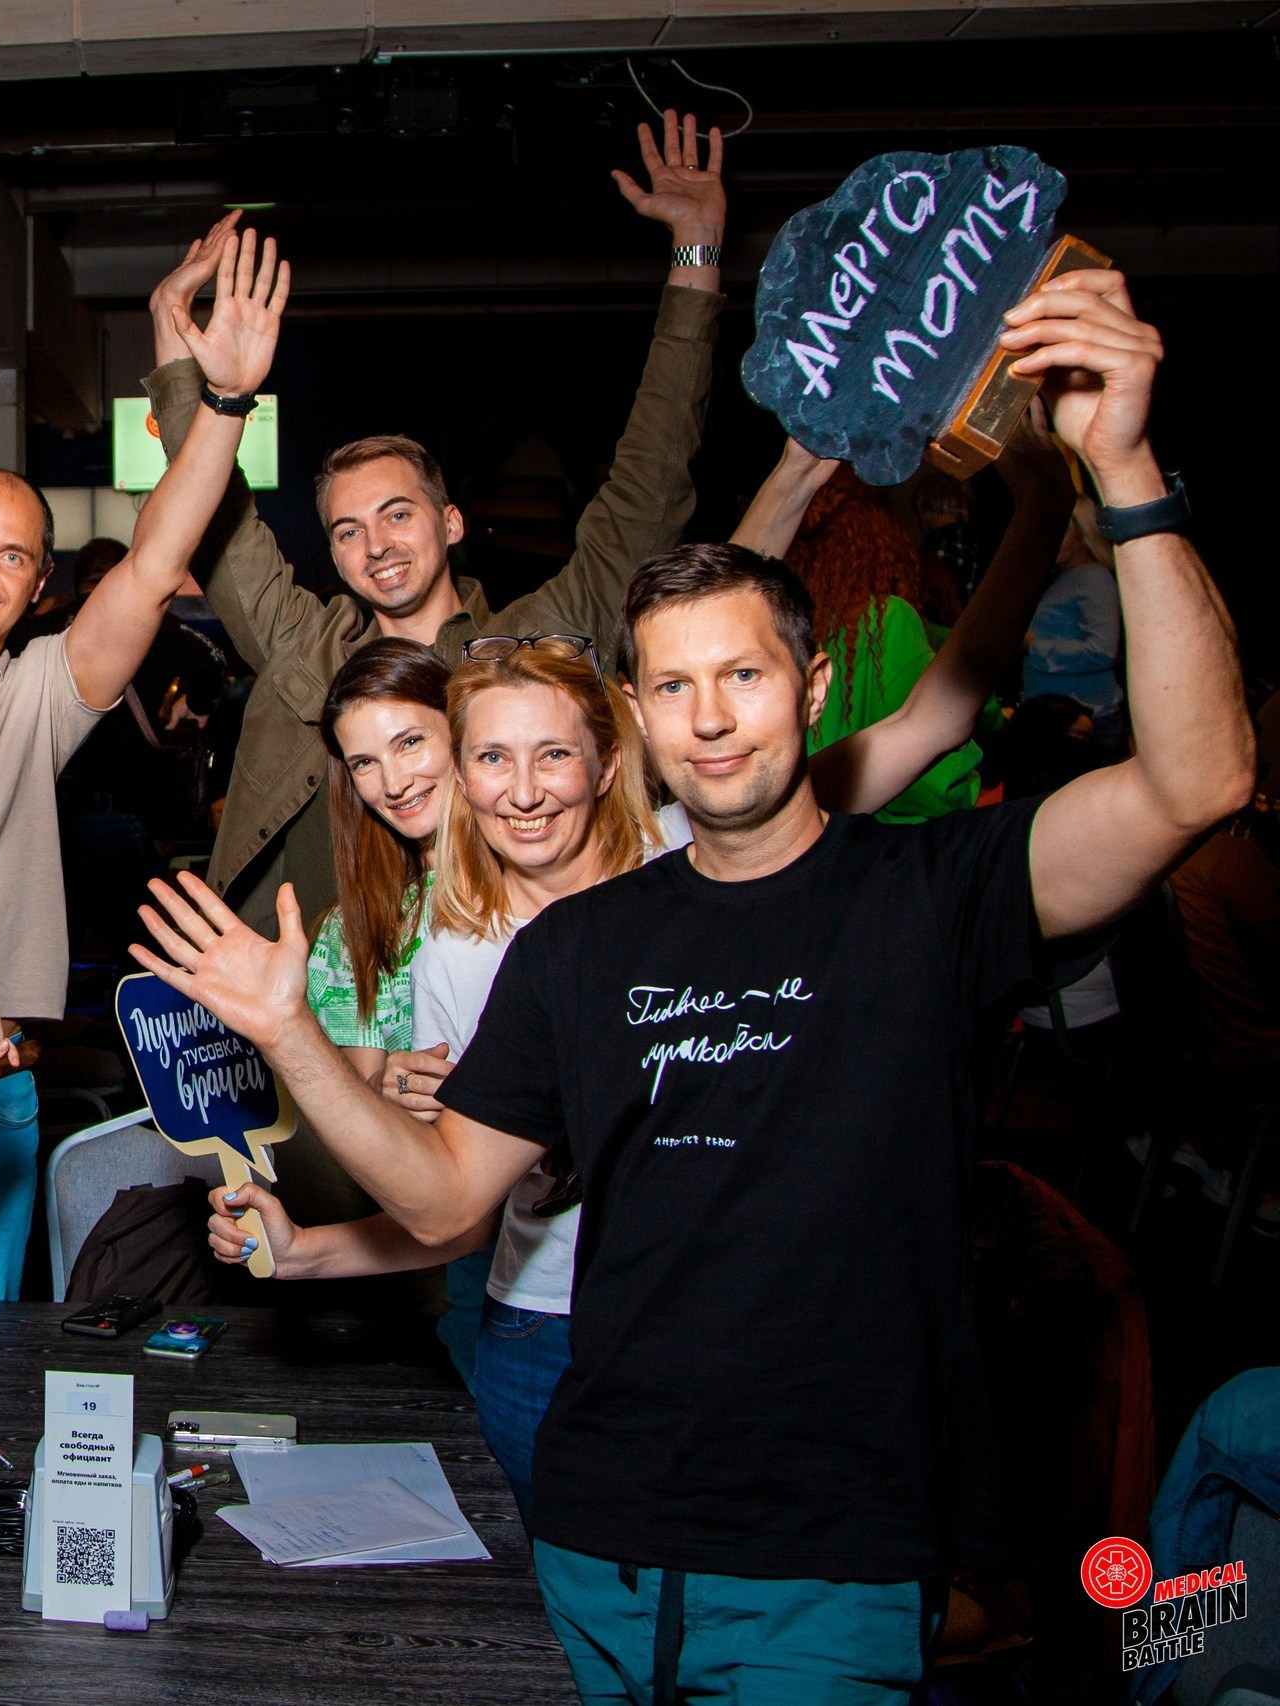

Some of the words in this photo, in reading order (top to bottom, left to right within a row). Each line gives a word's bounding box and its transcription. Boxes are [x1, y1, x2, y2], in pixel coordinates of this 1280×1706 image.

[183, 1037, 242, 1067] ТУСОВКА
[82, 1401, 97, 1411] 19
[72, 1430, 103, 1440] Всегда
[60, 1441, 115, 1452] свободный
[63, 1453, 112, 1463] официант
